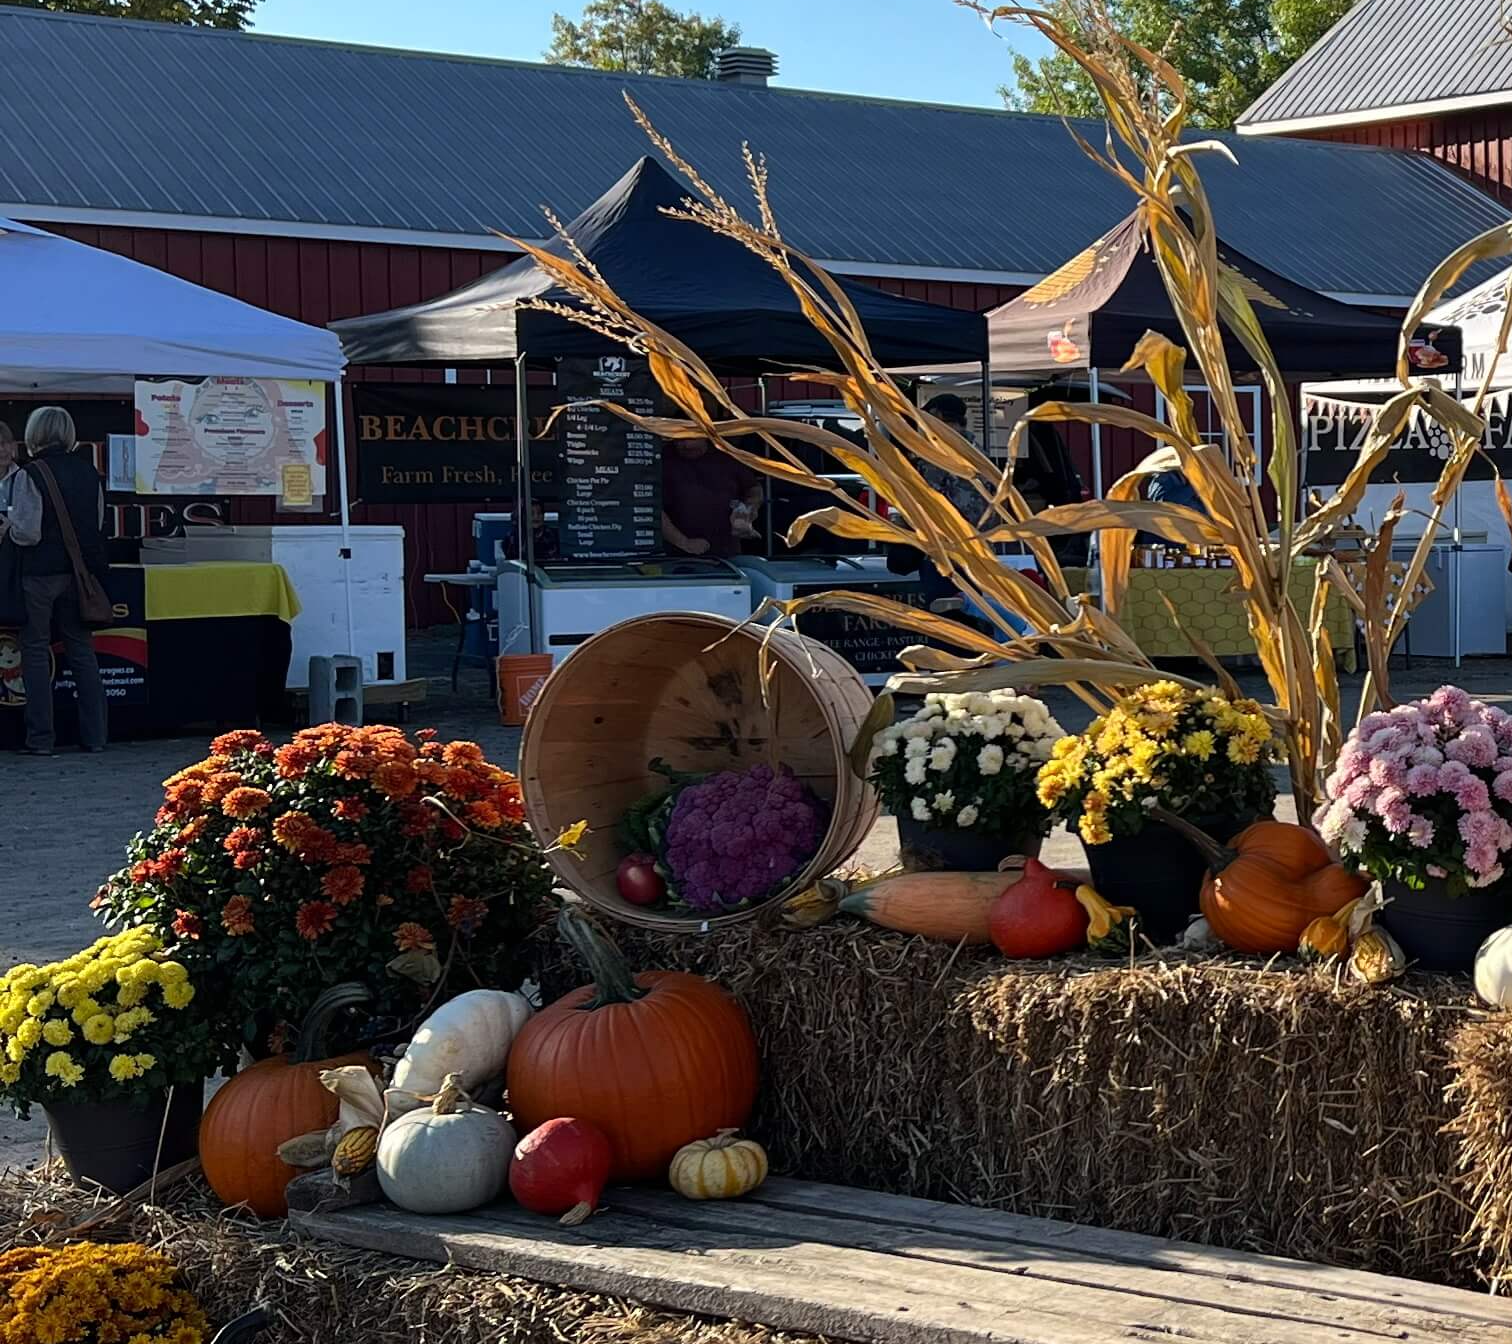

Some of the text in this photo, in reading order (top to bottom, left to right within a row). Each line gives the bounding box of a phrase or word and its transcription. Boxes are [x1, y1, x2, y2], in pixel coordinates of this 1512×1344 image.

[381, 464, 552, 485] Farm Fresh, Fee
